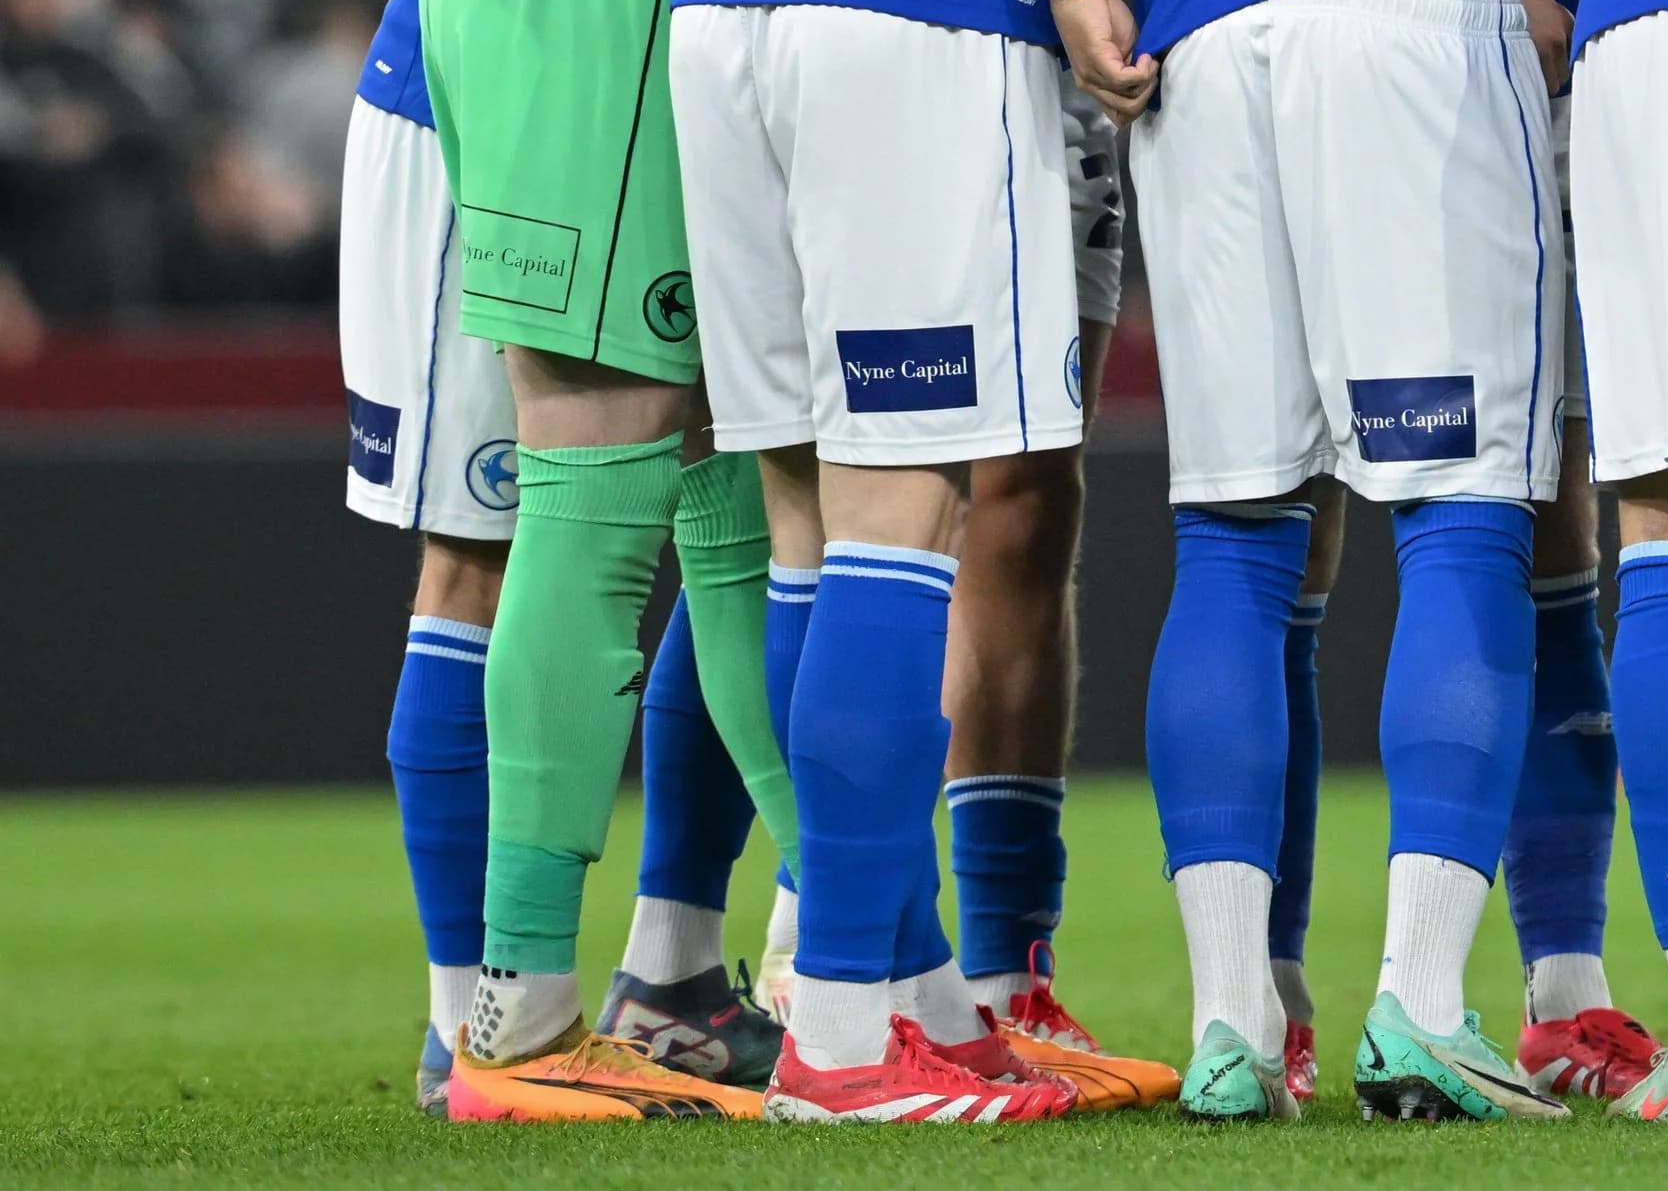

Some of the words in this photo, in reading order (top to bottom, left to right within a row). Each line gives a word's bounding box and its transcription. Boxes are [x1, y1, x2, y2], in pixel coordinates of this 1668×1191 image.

[463, 238, 495, 264] yne
[501, 248, 566, 277] Capital
[845, 361, 896, 386] Nyne
[901, 356, 968, 384] Capital
[1352, 410, 1395, 436] Nyne
[1401, 407, 1468, 433] Capital
